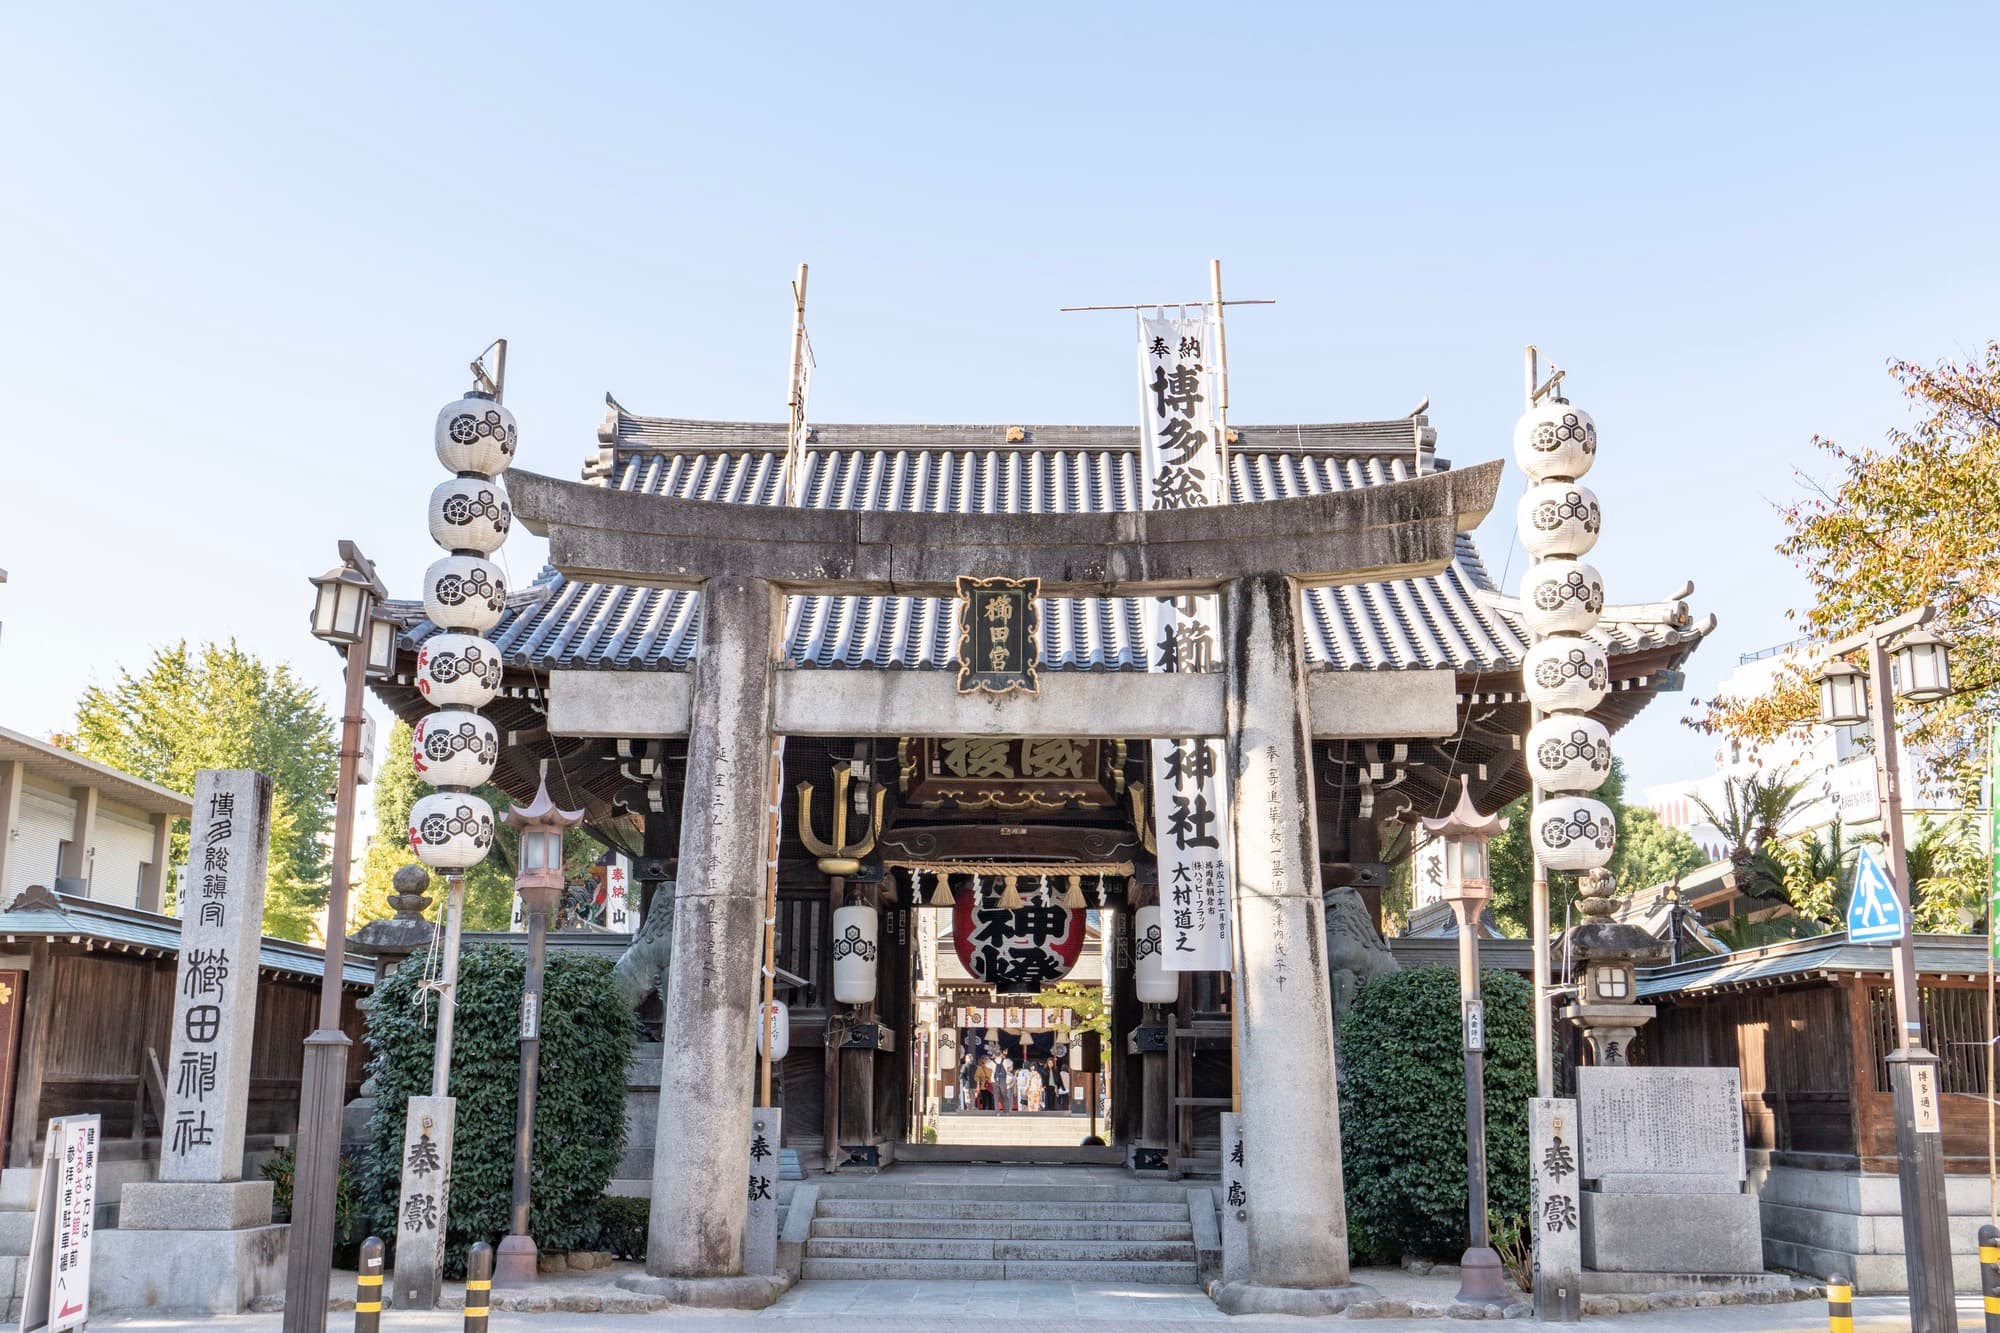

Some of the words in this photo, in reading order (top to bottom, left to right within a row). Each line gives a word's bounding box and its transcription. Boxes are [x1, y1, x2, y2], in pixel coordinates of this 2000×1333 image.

[1149, 336, 1201, 359] 奉納
[611, 867, 625, 898] 奉納
[1171, 861, 1196, 952] 大村道之
[1605, 1041, 1623, 1063] 奉
